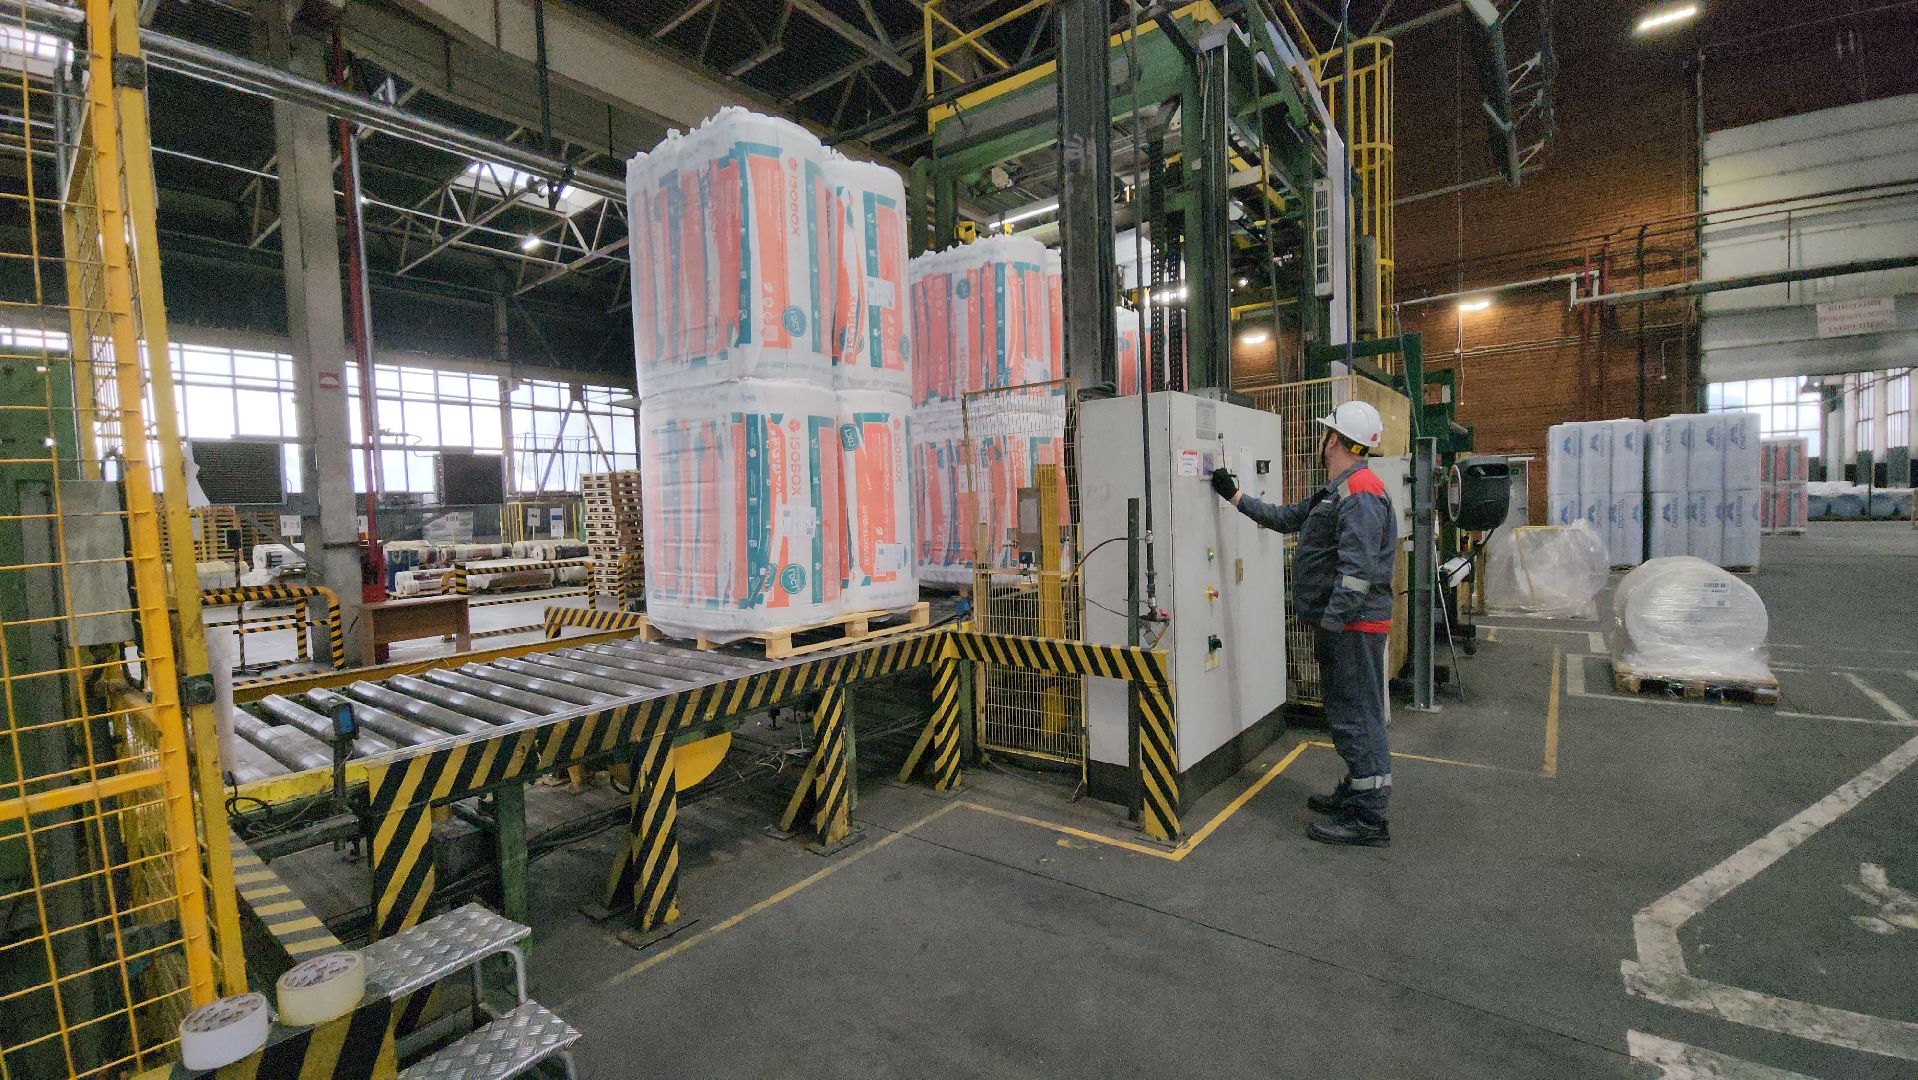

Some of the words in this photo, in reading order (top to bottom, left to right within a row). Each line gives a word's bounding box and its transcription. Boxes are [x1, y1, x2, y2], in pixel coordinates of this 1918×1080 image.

[790, 176, 800, 237] ISOBOX
[790, 436, 802, 496] ISOBOX
[787, 567, 801, 591] ГОСТ
